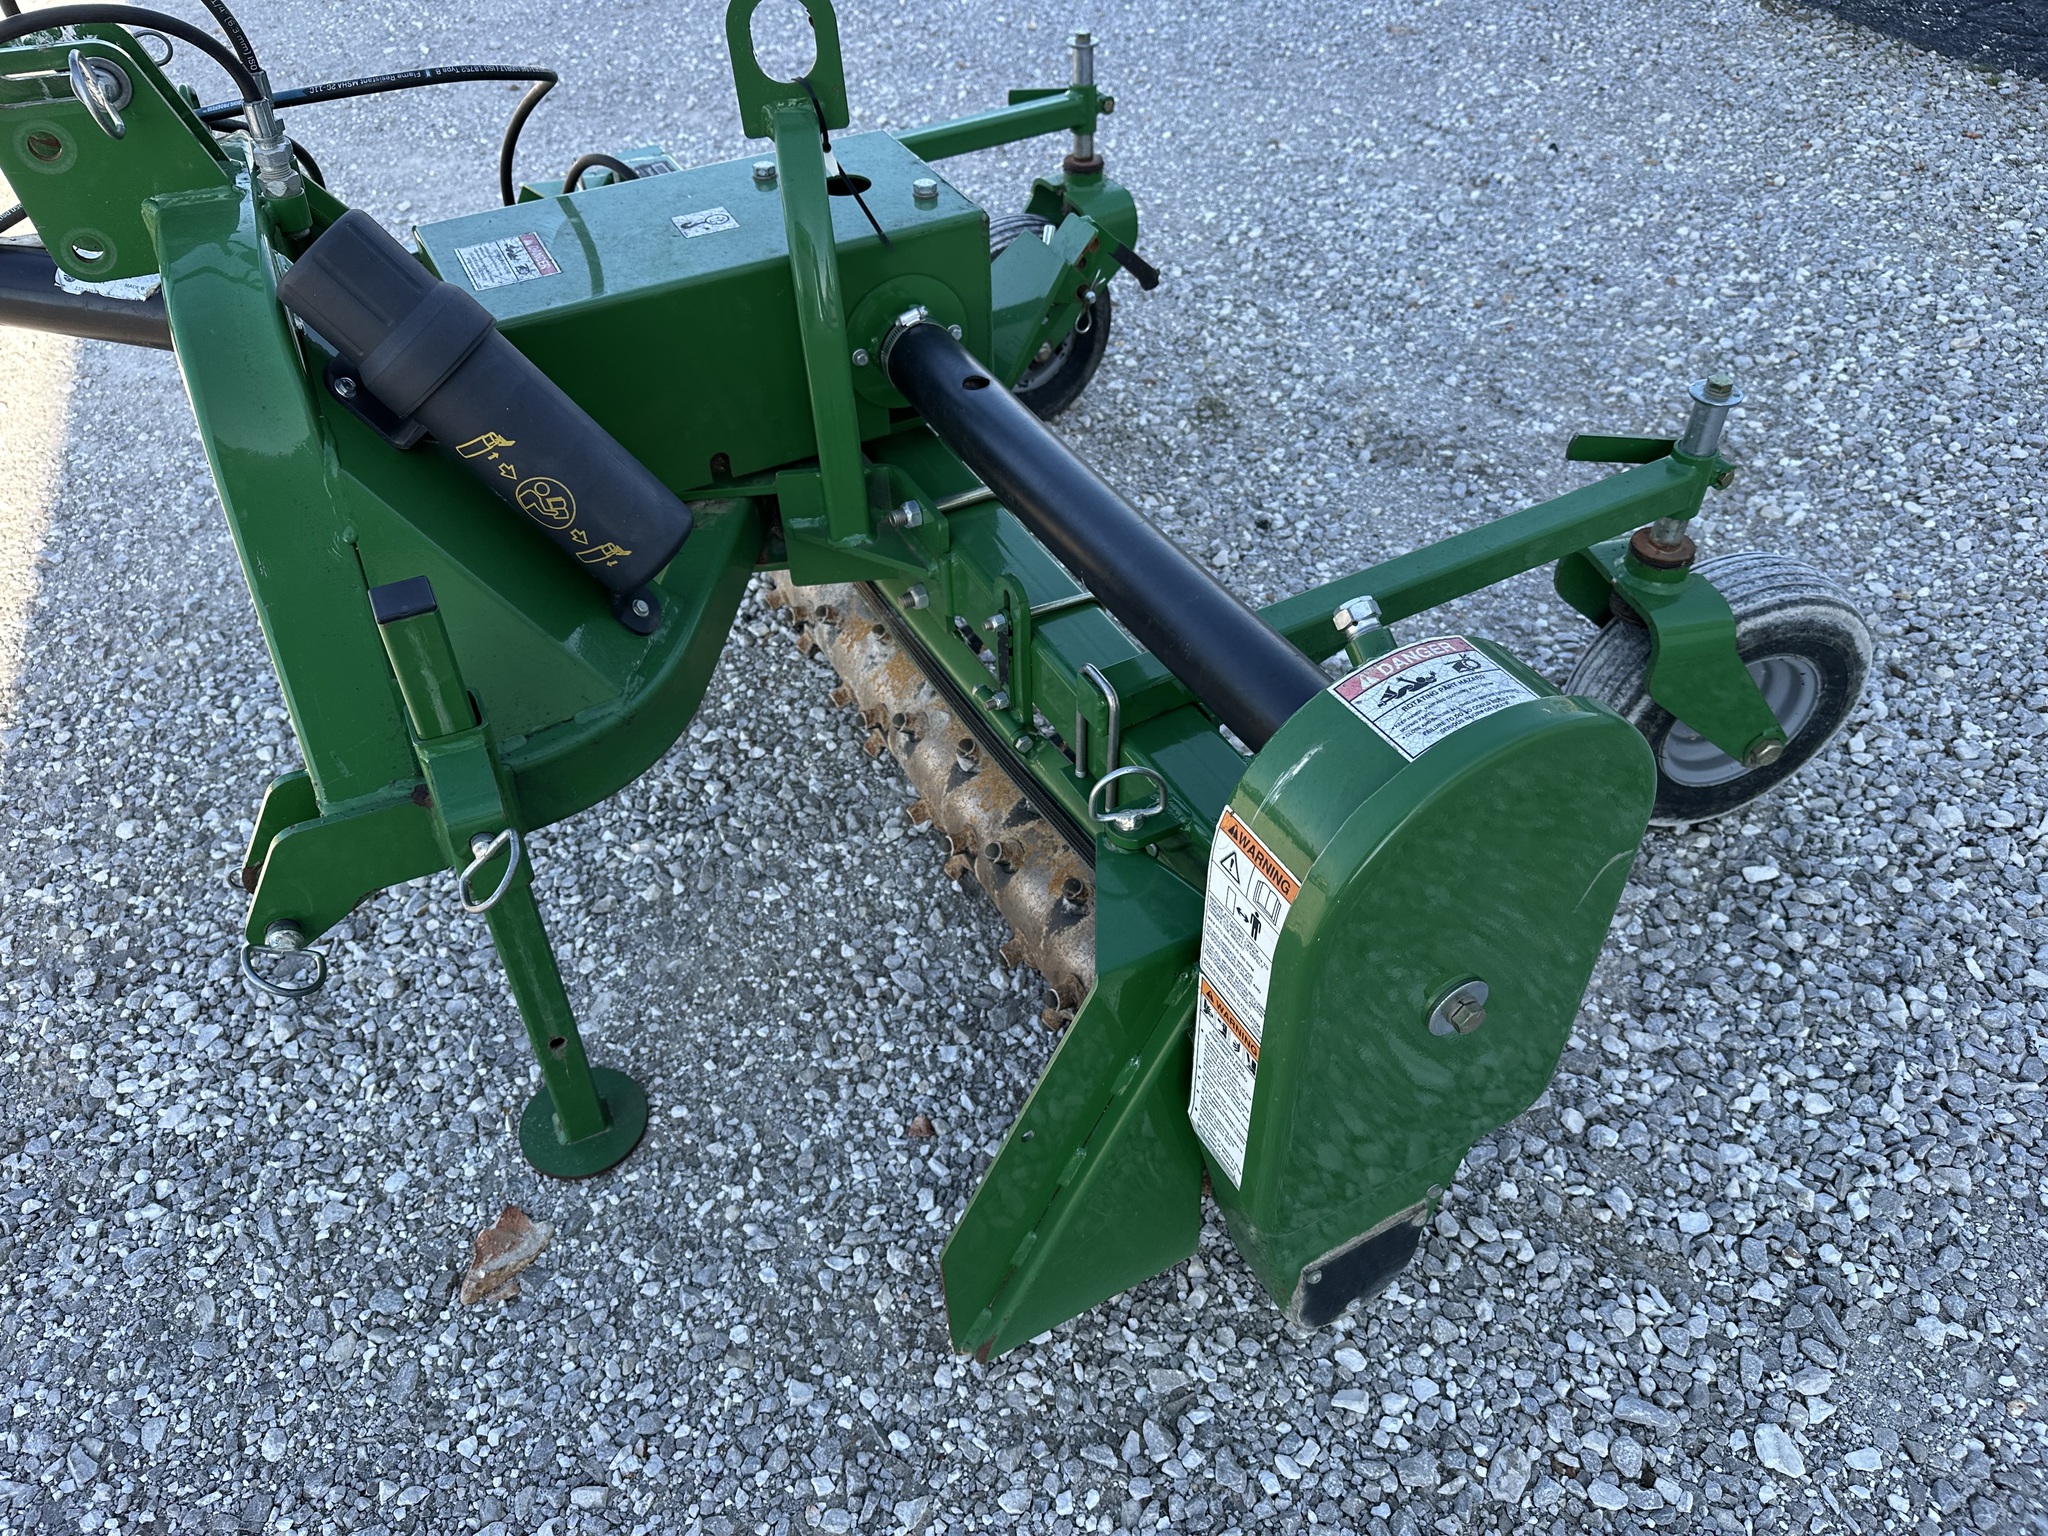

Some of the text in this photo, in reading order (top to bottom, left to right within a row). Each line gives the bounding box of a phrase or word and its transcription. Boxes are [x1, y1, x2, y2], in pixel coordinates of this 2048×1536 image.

[247, 56, 258, 71] ISO
[442, 66, 460, 74] Type
[338, 80, 359, 89] MSHA
[360, 75, 396, 85] Resistant
[1376, 640, 1457, 676] DANGER
[1401, 674, 1486, 712] ROTATING PART HAZARD
[1422, 720, 1446, 735] FAILURE
[1454, 711, 1464, 719] DO
[1472, 701, 1491, 711] COULD
[1440, 719, 1465, 734] SERIOUS
[1238, 831, 1291, 896] WARNING
[1216, 1000, 1258, 1057] WARNING
